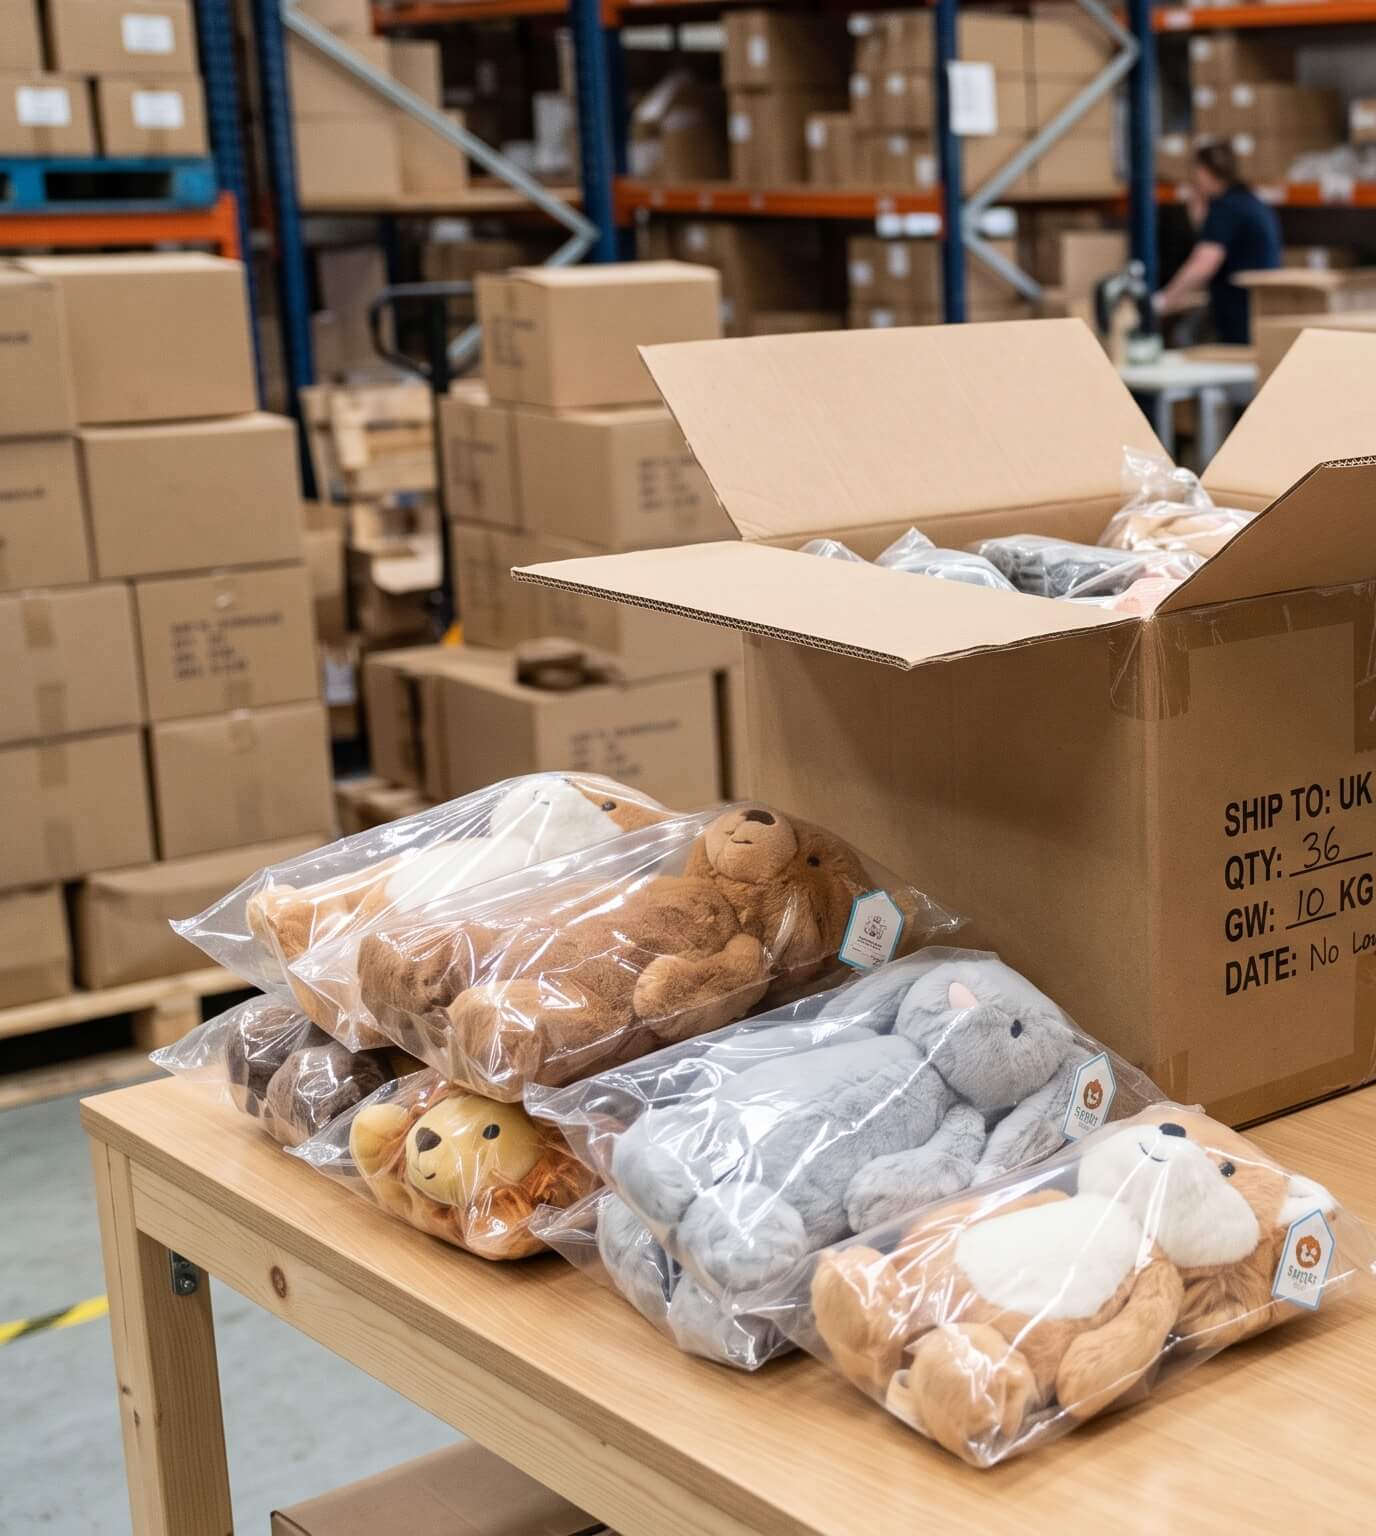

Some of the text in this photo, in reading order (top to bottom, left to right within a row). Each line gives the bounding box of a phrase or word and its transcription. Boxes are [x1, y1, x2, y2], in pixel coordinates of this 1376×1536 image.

[1224, 793, 1283, 837] SHIP
[1291, 783, 1331, 822] TO:
[1339, 771, 1372, 810] UK
[1224, 846, 1283, 890] QTY:
[1302, 826, 1341, 869] 36
[1224, 873, 1374, 942] GW: 10 KG
[1225, 946, 1297, 996] DATE:
[1309, 936, 1340, 971] No
